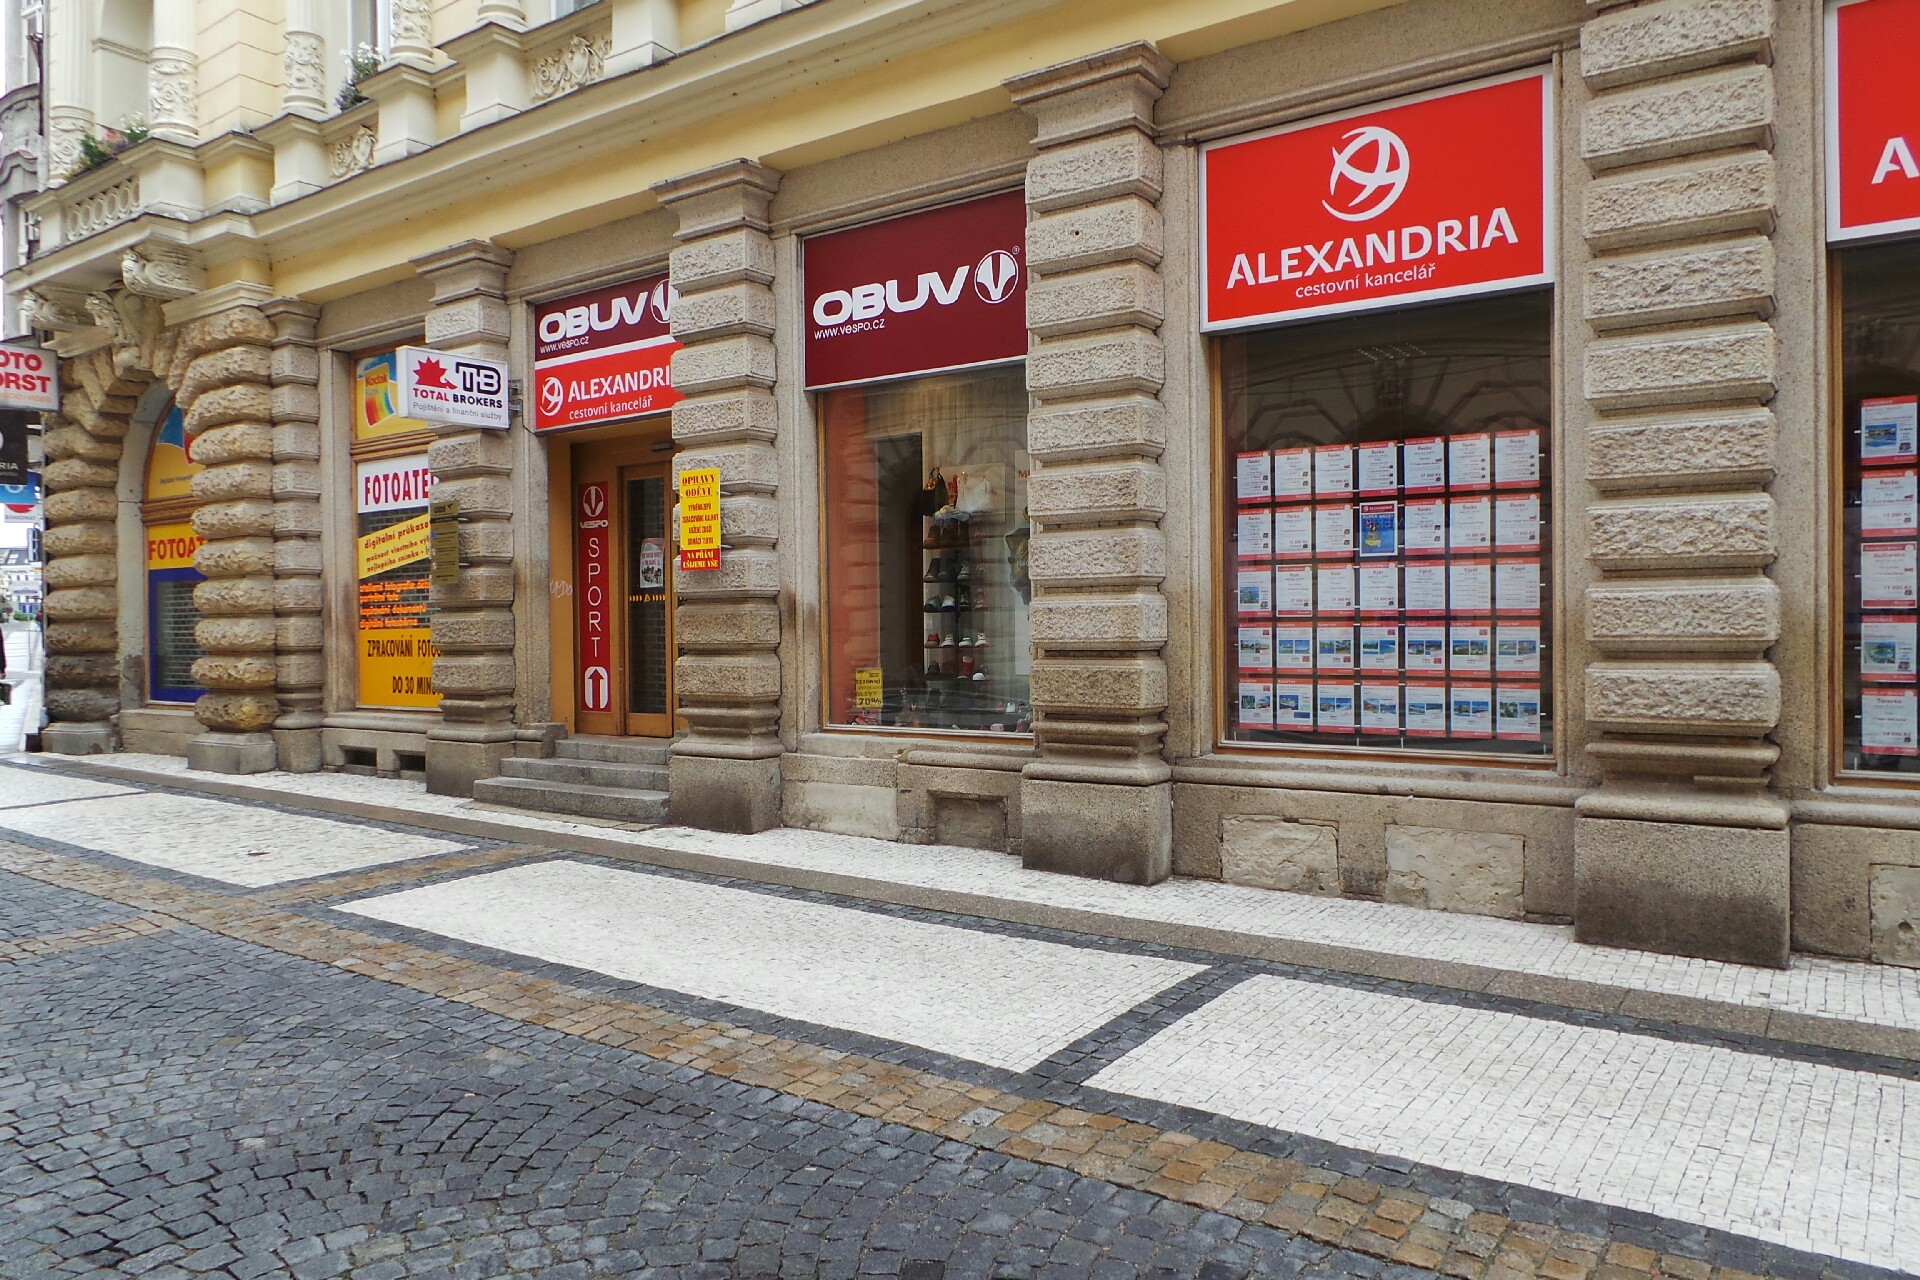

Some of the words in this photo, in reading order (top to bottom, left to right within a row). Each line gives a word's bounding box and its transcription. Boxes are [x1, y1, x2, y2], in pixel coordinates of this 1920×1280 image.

[1871, 137, 1920, 185] A
[1226, 206, 1519, 290] ALEXANDRIA
[1295, 273, 1360, 299] cestovní
[1365, 262, 1436, 289] kancelář
[812, 264, 970, 327] OBUV
[539, 291, 649, 343] OBUV
[0, 372, 51, 393] RST
[365, 373, 388, 387] Kodak
[456, 361, 502, 396] TB
[412, 388, 450, 402] TOTAL
[453, 394, 503, 409] BROKERS
[569, 402, 608, 420] cestovní
[610, 395, 653, 413] kancelář
[413, 401, 444, 413] Pojištění
[452, 407, 479, 417] finanční
[481, 410, 502, 421] služby
[682, 473, 715, 486] OPRAVY
[685, 485, 712, 497] ODĚVŮ
[580, 520, 608, 529] VESPO
[587, 537, 602, 658] SPORT
[367, 634, 413, 658] ZPRACOVÁNÍ
[392, 676, 402, 694] DO
[404, 676, 414, 694] 30
[858, 697, 882, 706] 70%
